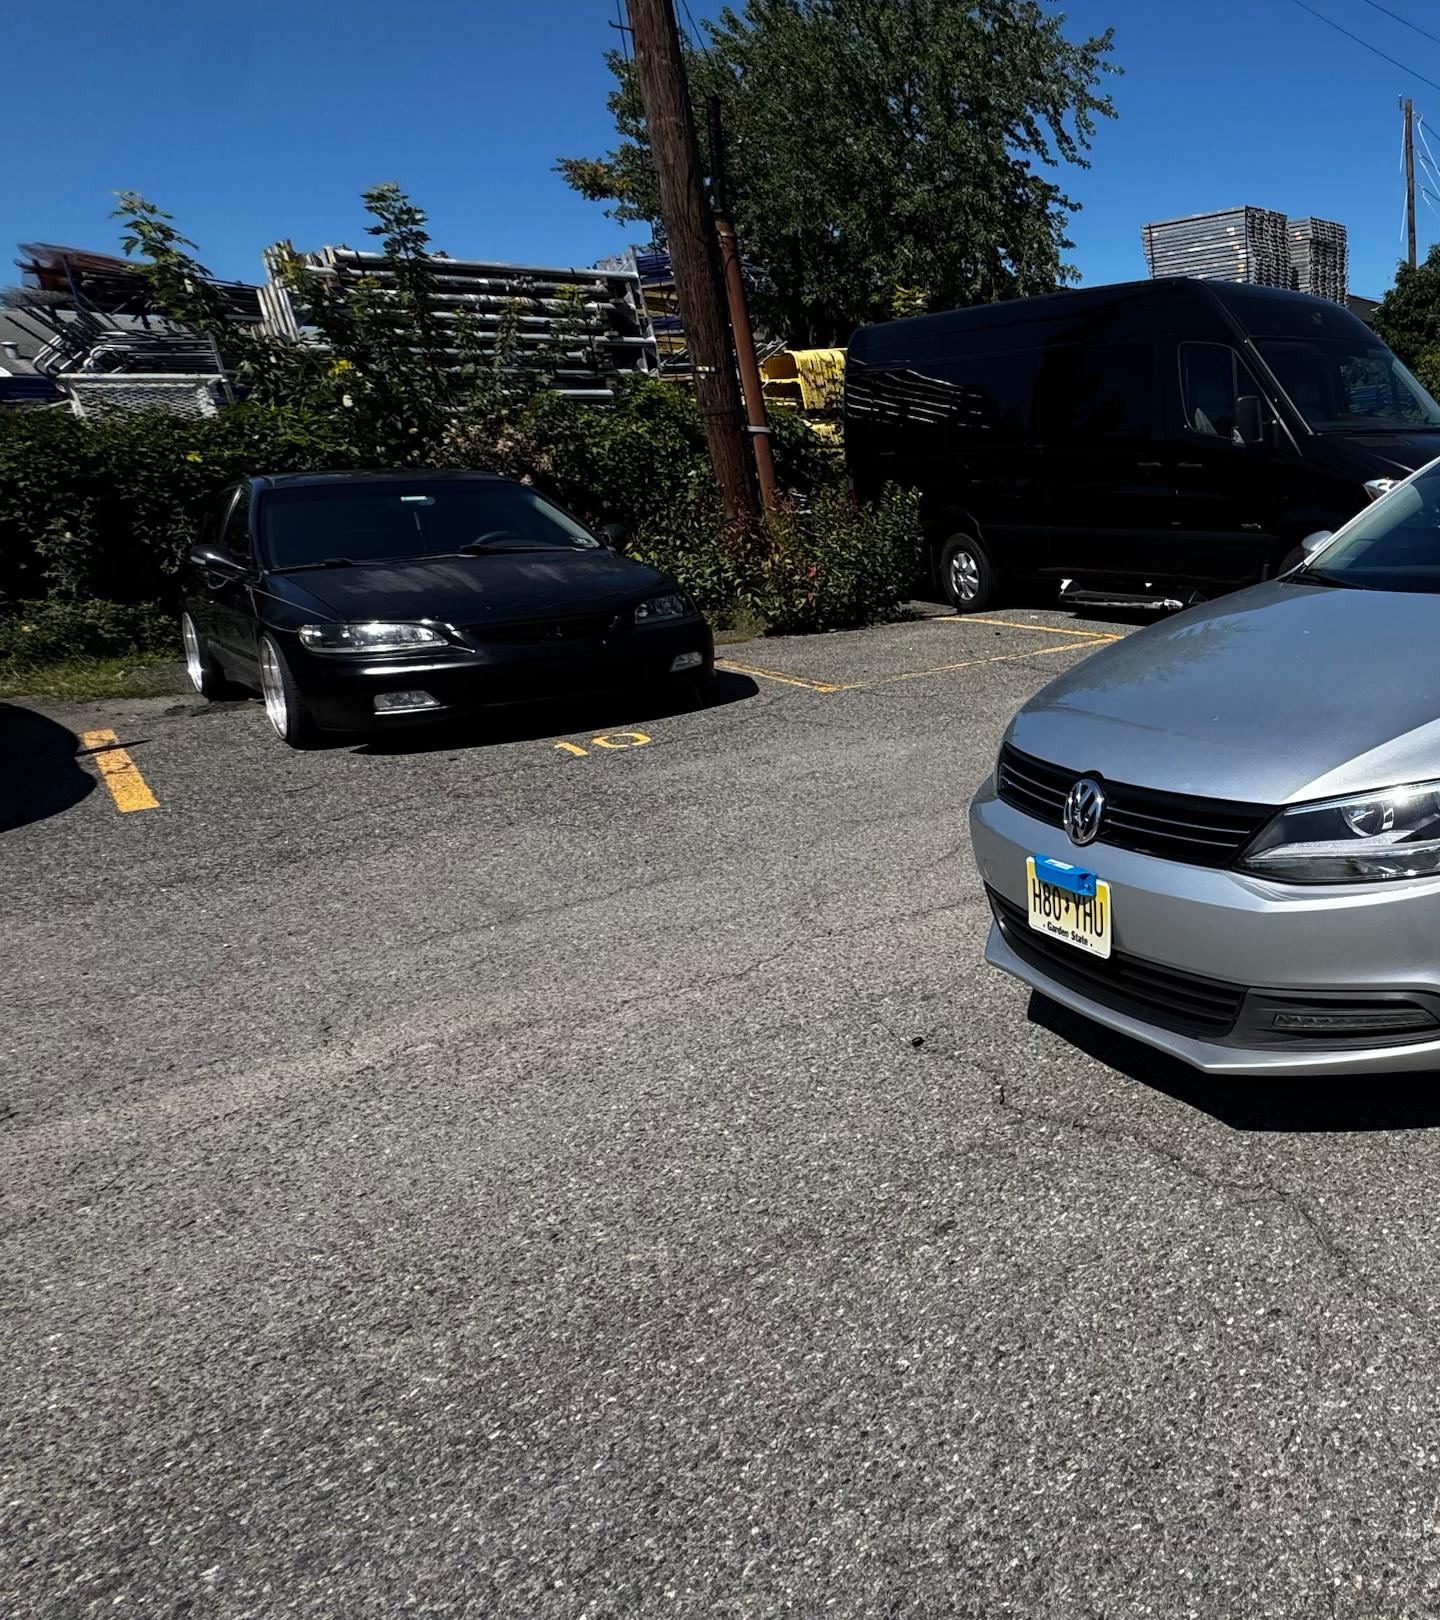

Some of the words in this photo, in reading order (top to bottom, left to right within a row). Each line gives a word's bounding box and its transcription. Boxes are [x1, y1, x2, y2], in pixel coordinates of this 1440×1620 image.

[554, 732, 651, 756] 10
[1047, 921, 1070, 938] Garden
[1071, 930, 1089, 946] State
